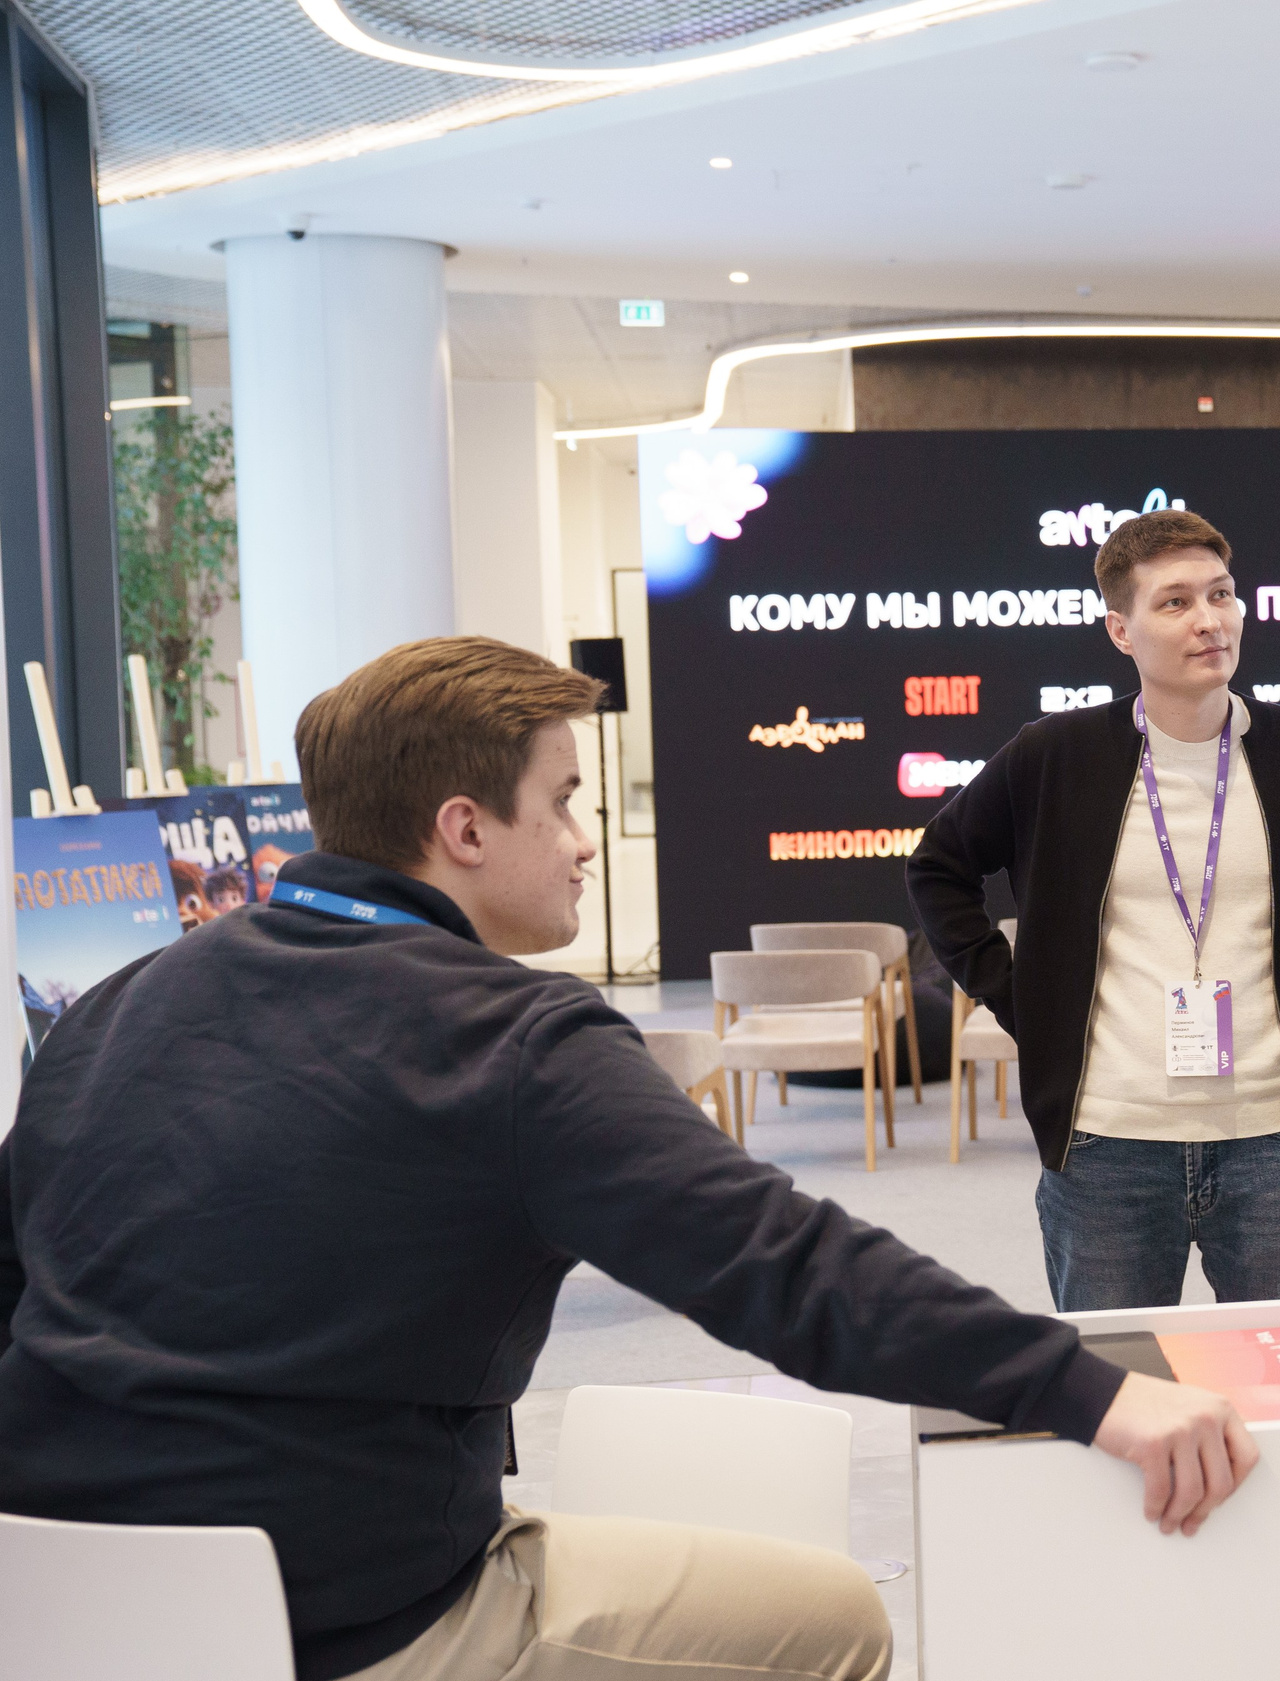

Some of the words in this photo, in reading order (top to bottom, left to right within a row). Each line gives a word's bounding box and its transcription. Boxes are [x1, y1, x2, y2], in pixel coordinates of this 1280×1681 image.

[728, 592, 856, 632] КОМУ
[866, 591, 941, 630] МЫ
[904, 675, 981, 716] START
[1221, 1050, 1230, 1069] VIP
